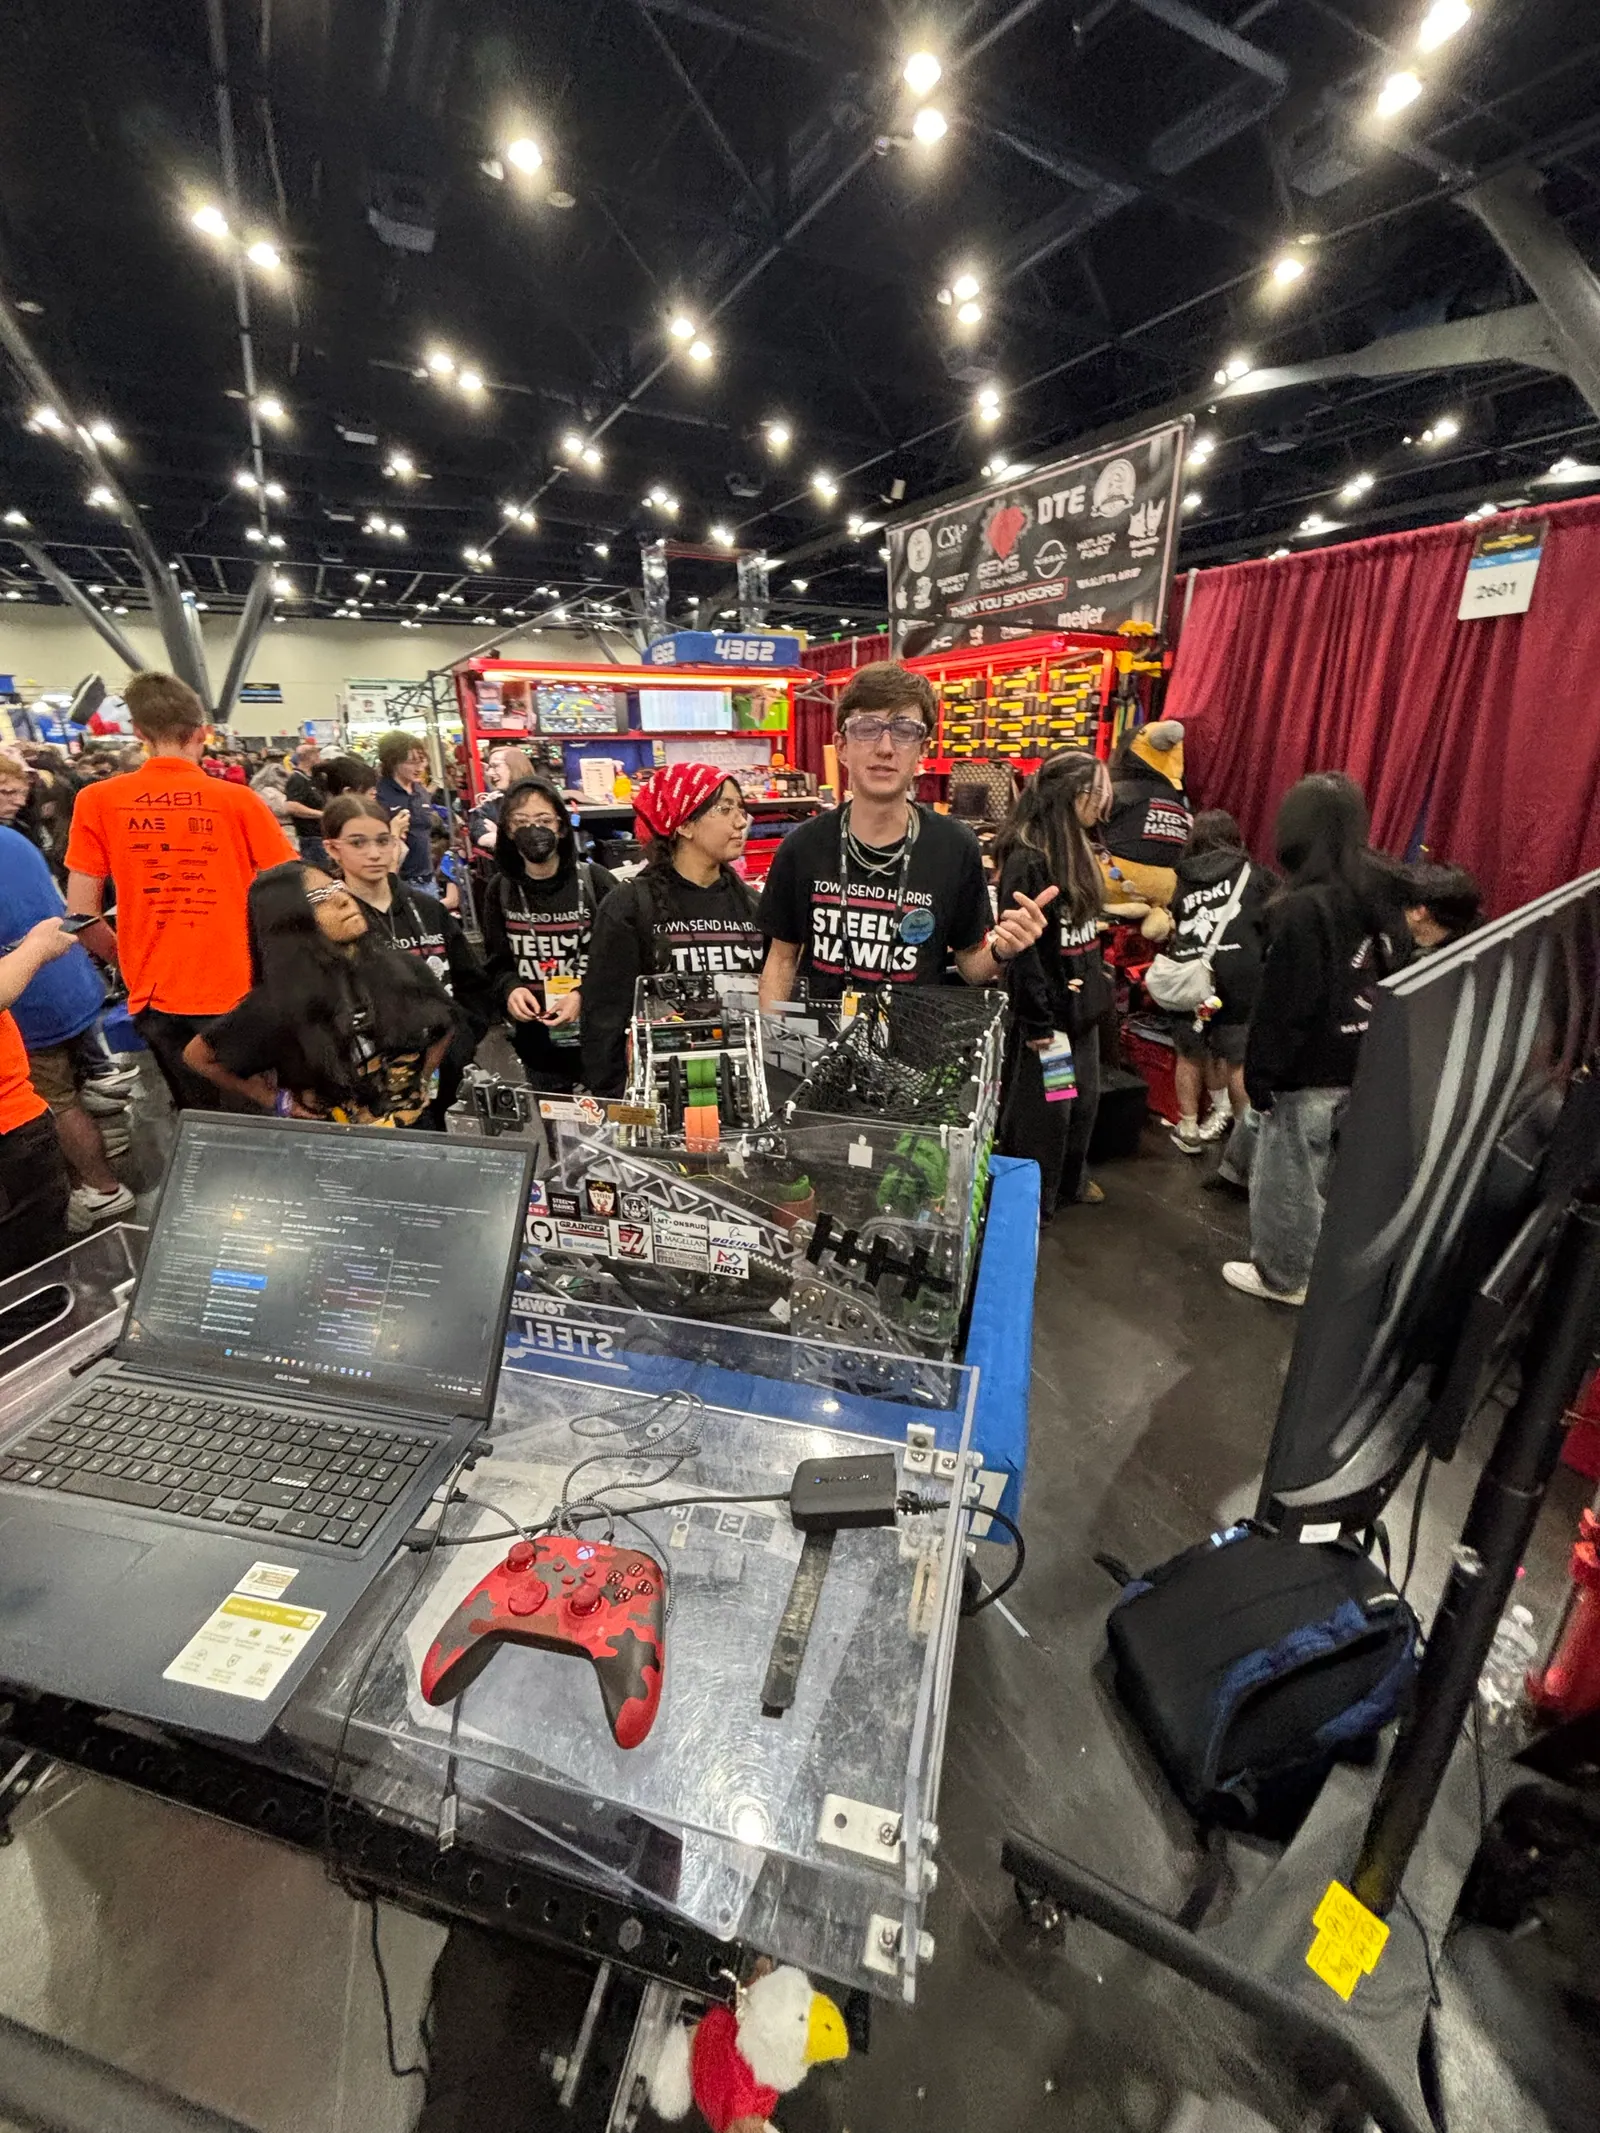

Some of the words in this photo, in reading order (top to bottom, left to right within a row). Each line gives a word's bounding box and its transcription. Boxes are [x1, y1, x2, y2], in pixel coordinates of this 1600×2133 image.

[1038, 485, 1086, 525] DTE
[949, 601, 978, 618] THANK
[979, 596, 1002, 612] YOU
[1057, 603, 1106, 629] meijer
[714, 638, 776, 661] 4362
[134, 791, 203, 806] 4481
[693, 783, 709, 804] molex
[888, 889, 932, 906] HRRIS
[813, 907, 891, 942] STEEL
[506, 932, 567, 956] TEEL
[813, 935, 918, 971] HAWKS
[672, 945, 741, 972] TEEL
[559, 1221, 605, 1232] GRAINGER
[673, 1220, 706, 1230] ONSRUD
[664, 1235, 706, 1248] MAGELLAN
[712, 1237, 758, 1248] BOEING
[713, 1263, 746, 1276] FIRST
